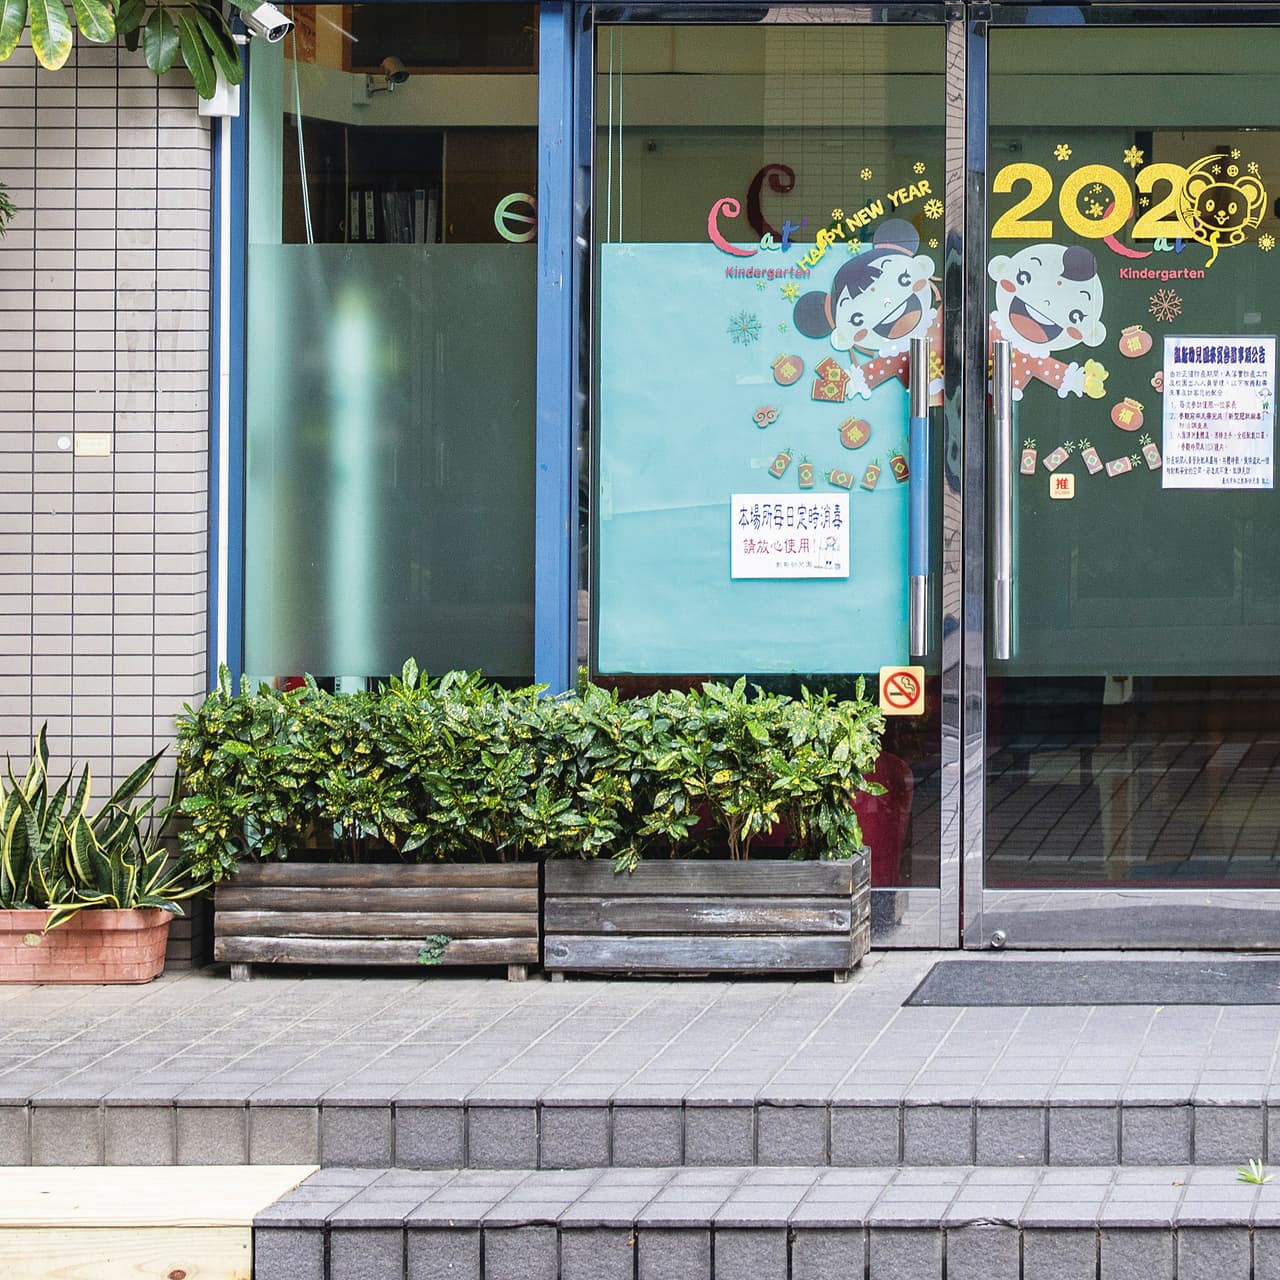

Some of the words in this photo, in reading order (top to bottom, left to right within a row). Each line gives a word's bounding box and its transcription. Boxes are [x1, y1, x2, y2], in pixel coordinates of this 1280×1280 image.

[845, 199, 885, 233] NEW
[886, 179, 933, 208] YEAR
[724, 265, 812, 281] Kindergarten
[1119, 267, 1205, 282] Kindergarten
[1055, 477, 1069, 490] 推
